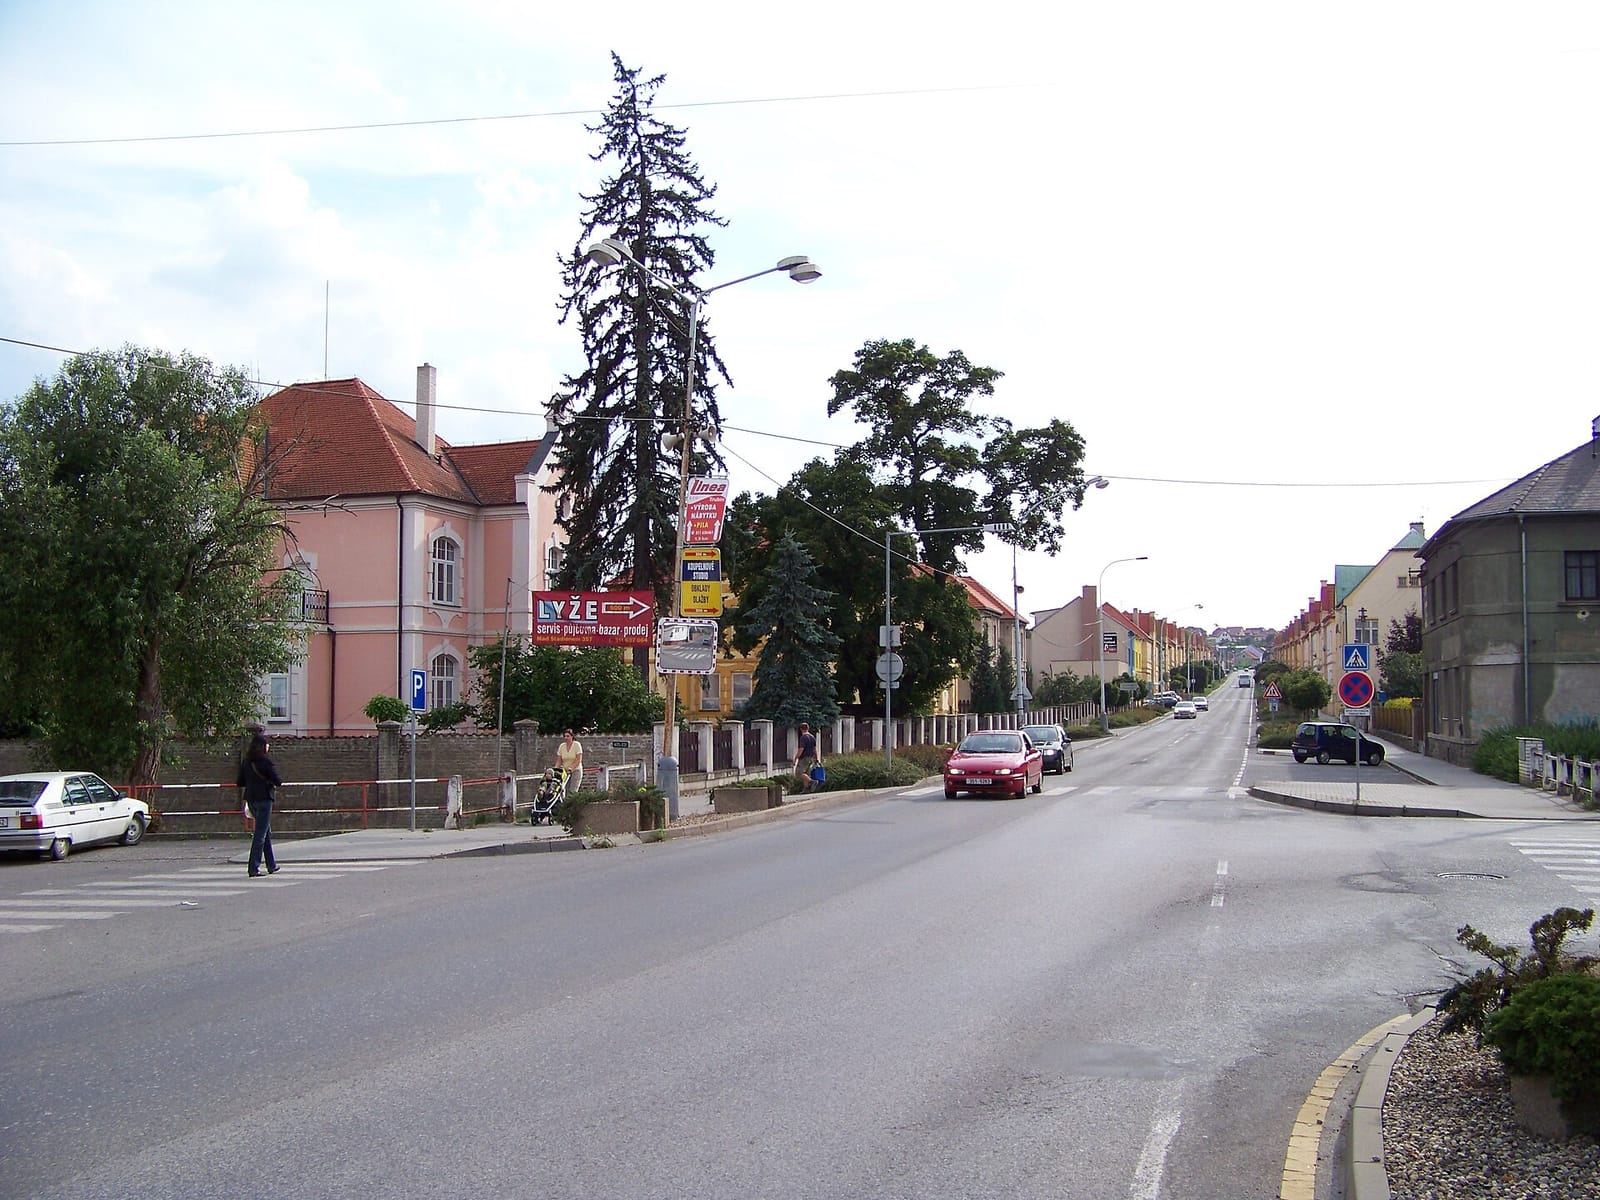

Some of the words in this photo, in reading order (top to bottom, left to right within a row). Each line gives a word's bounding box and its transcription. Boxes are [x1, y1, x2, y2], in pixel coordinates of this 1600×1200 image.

[690, 479, 727, 495] Linea
[538, 595, 598, 620] LYŽE
[536, 623, 561, 634] servis
[563, 623, 596, 637] půjčovna
[598, 624, 620, 636] bazar
[623, 623, 649, 638] prodej
[414, 674, 423, 698] P
